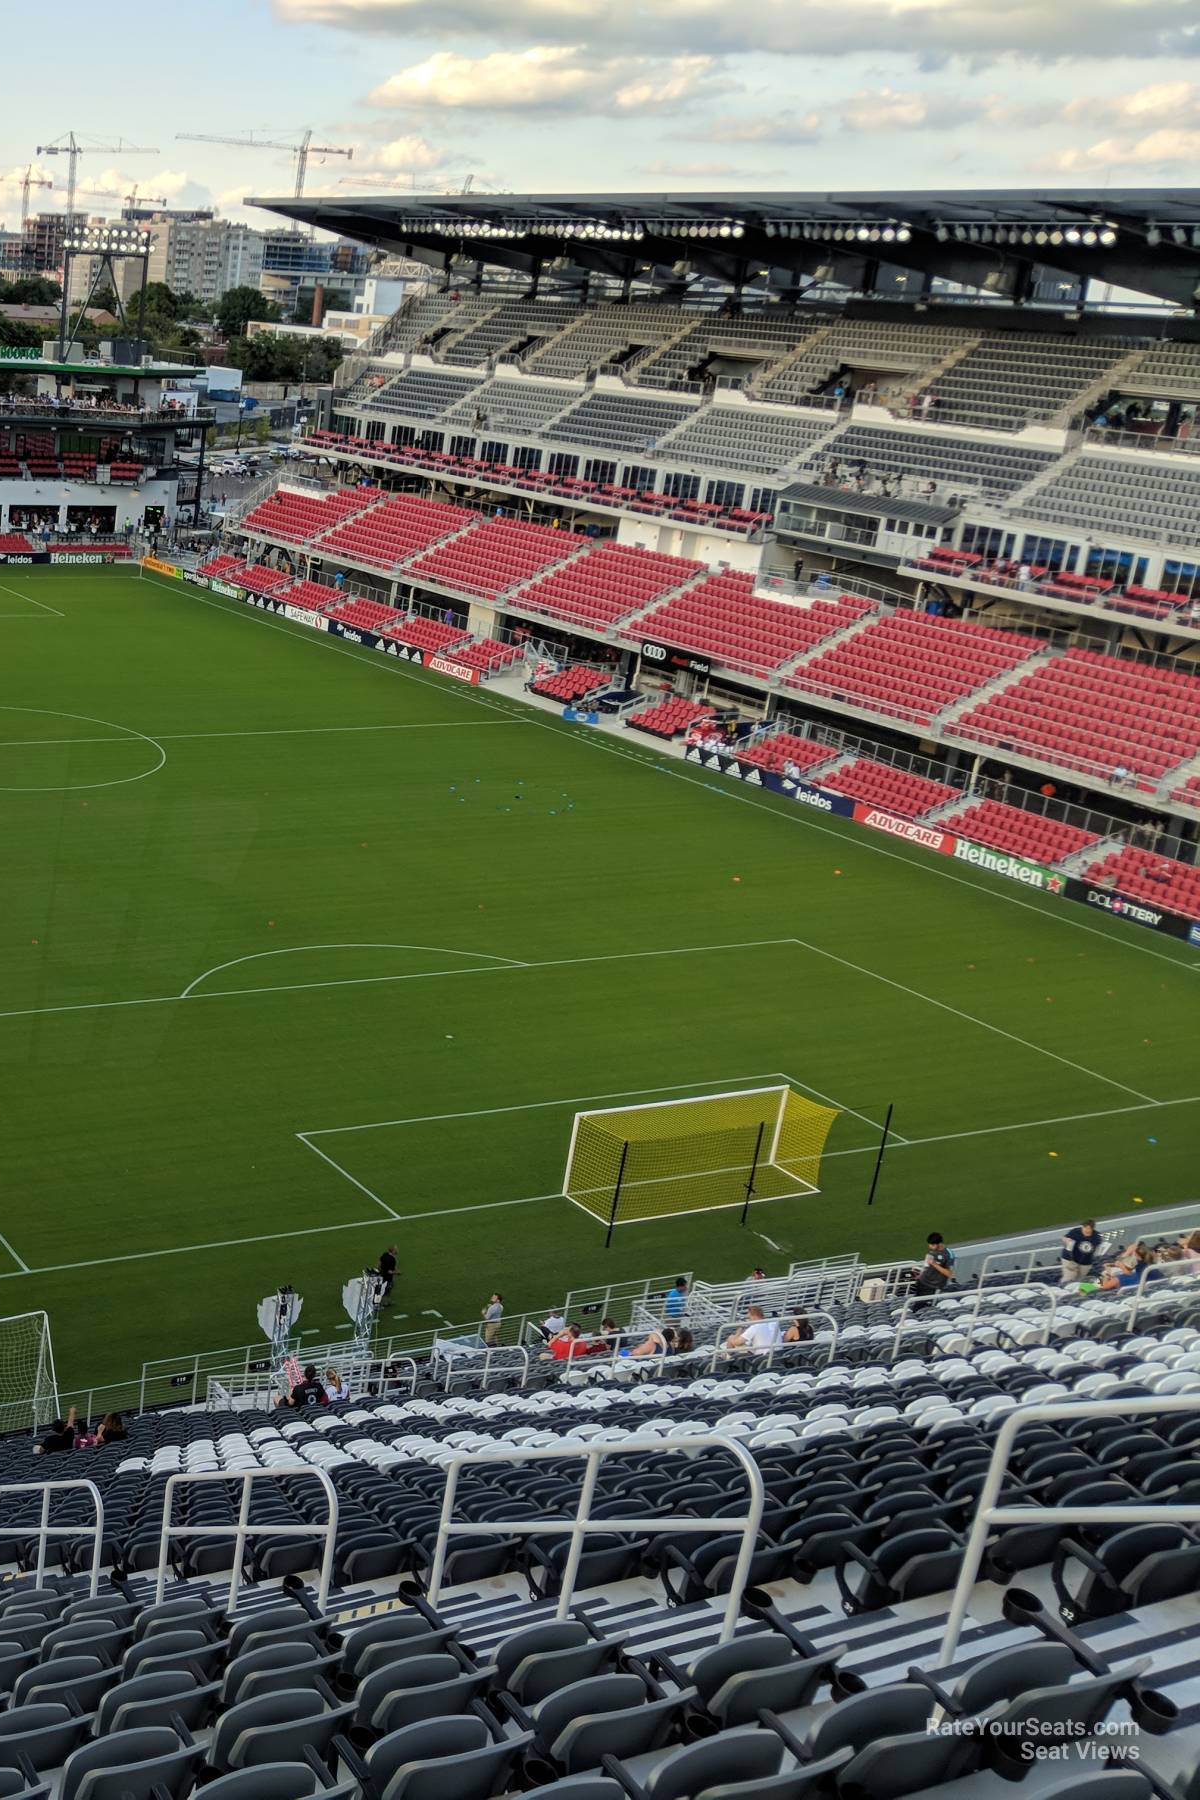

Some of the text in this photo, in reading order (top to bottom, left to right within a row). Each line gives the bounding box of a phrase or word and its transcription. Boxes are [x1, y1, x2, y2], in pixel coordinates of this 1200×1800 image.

[7, 555, 33, 564] leidos
[51, 553, 103, 564] Heineken
[211, 579, 238, 599] Heineken
[290, 607, 315, 624] SAFEWAY
[343, 629, 362, 644] leidos
[431, 657, 471, 680] ADVOCARE
[690, 660, 709, 673] Field
[795, 786, 832, 811] leidos
[866, 812, 942, 847] ADVOCARE
[953, 838, 1043, 888] Heineken
